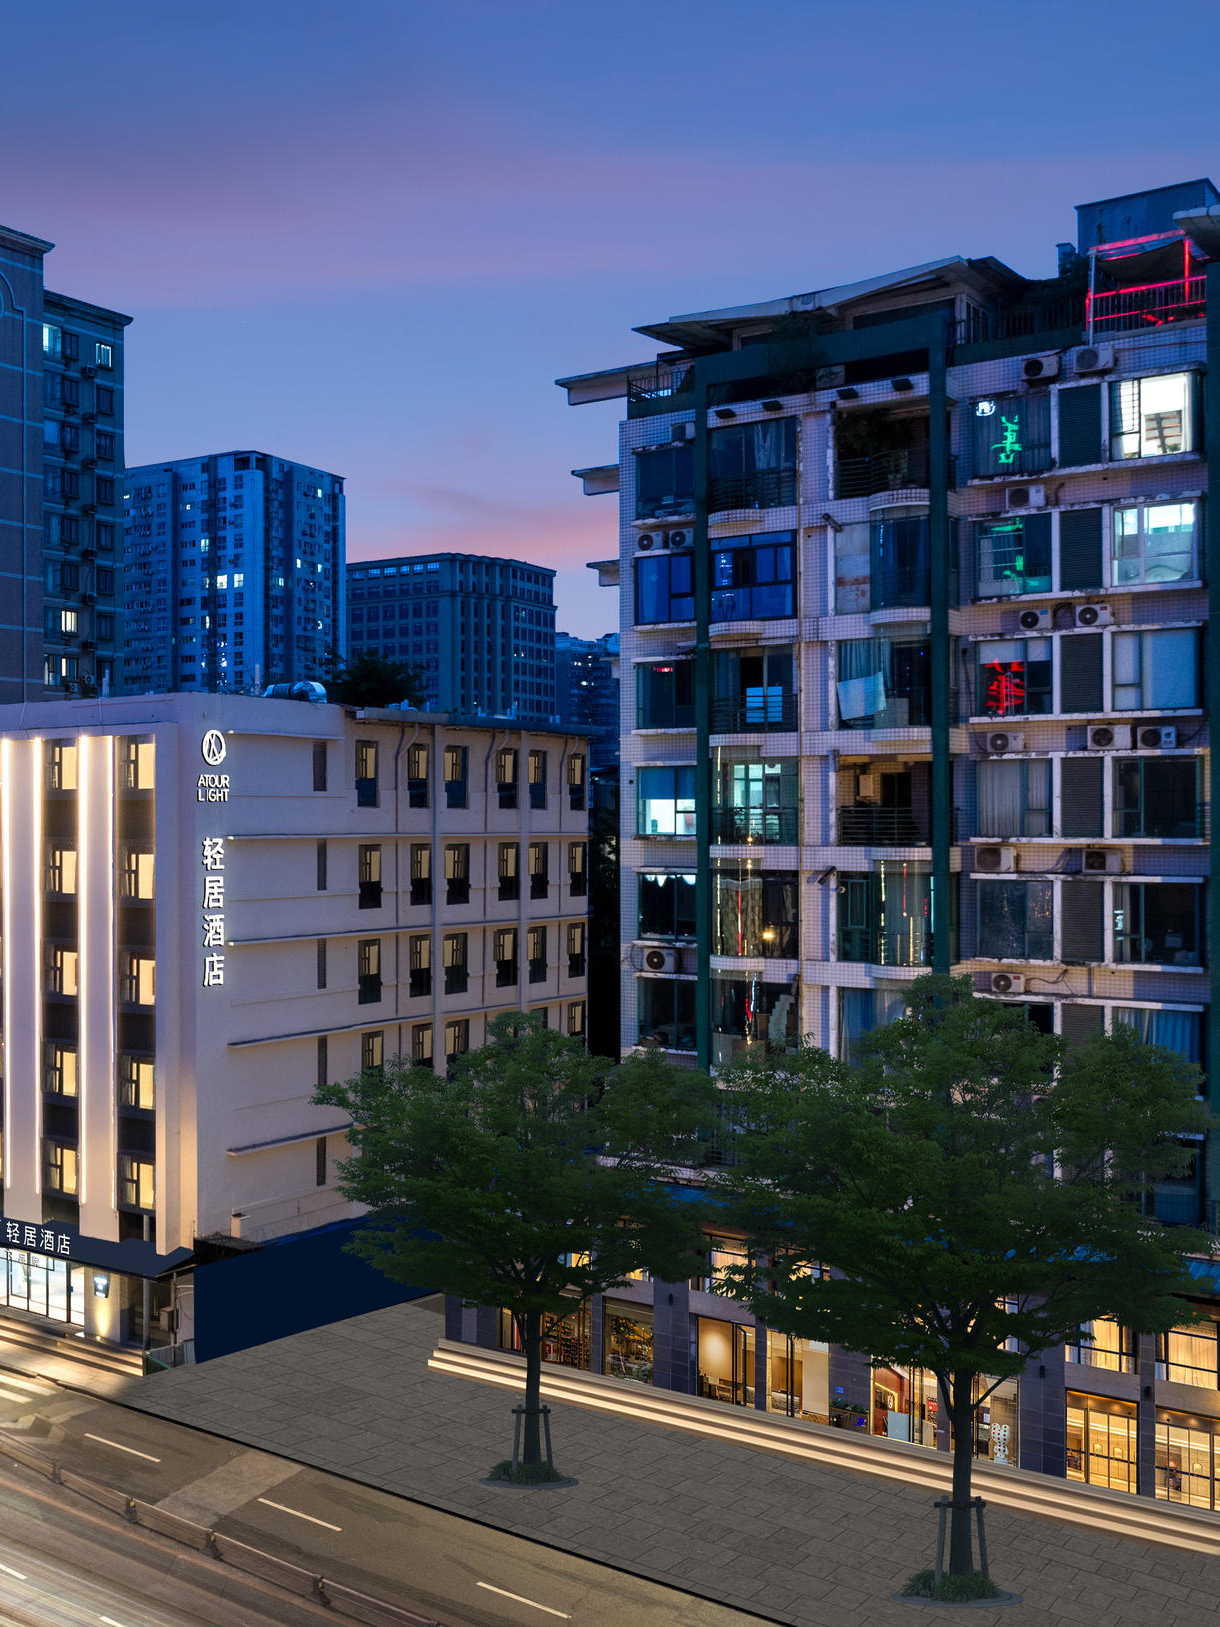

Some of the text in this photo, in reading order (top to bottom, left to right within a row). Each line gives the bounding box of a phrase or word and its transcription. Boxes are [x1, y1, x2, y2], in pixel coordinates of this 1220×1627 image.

[197, 774, 230, 788] ATOUR
[197, 788, 230, 802] LIGHT
[202, 836, 226, 987] 轻居酒店
[6, 1220, 71, 1256] 轻居酒店
